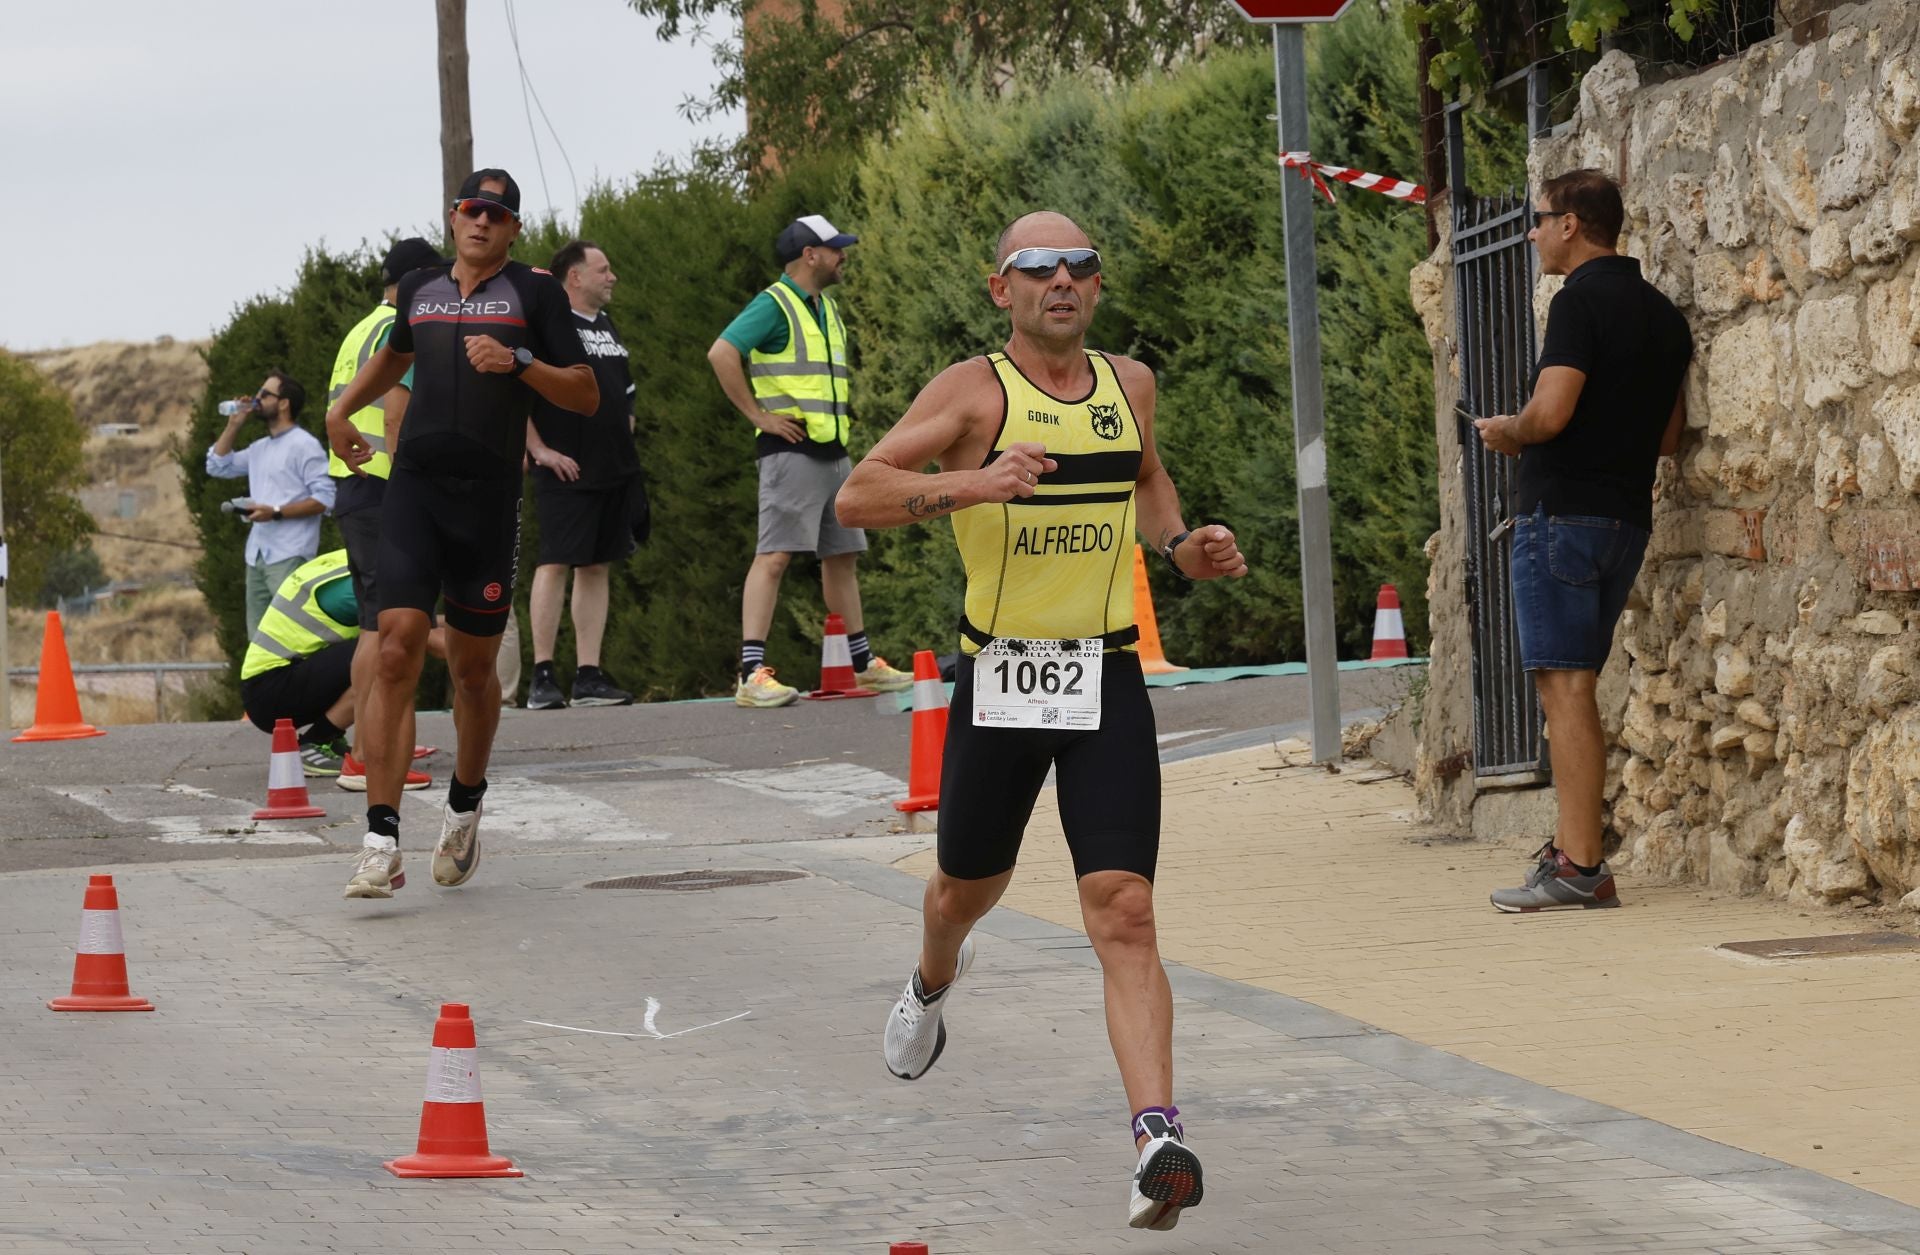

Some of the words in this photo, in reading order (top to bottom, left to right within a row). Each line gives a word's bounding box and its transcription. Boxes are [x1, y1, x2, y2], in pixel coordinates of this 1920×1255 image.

[416, 301, 511, 315] SUNDRIED
[1028, 410, 1060, 426] GOBIK
[1014, 523, 1113, 556] ALFREDO
[994, 660, 1084, 695] 1062
